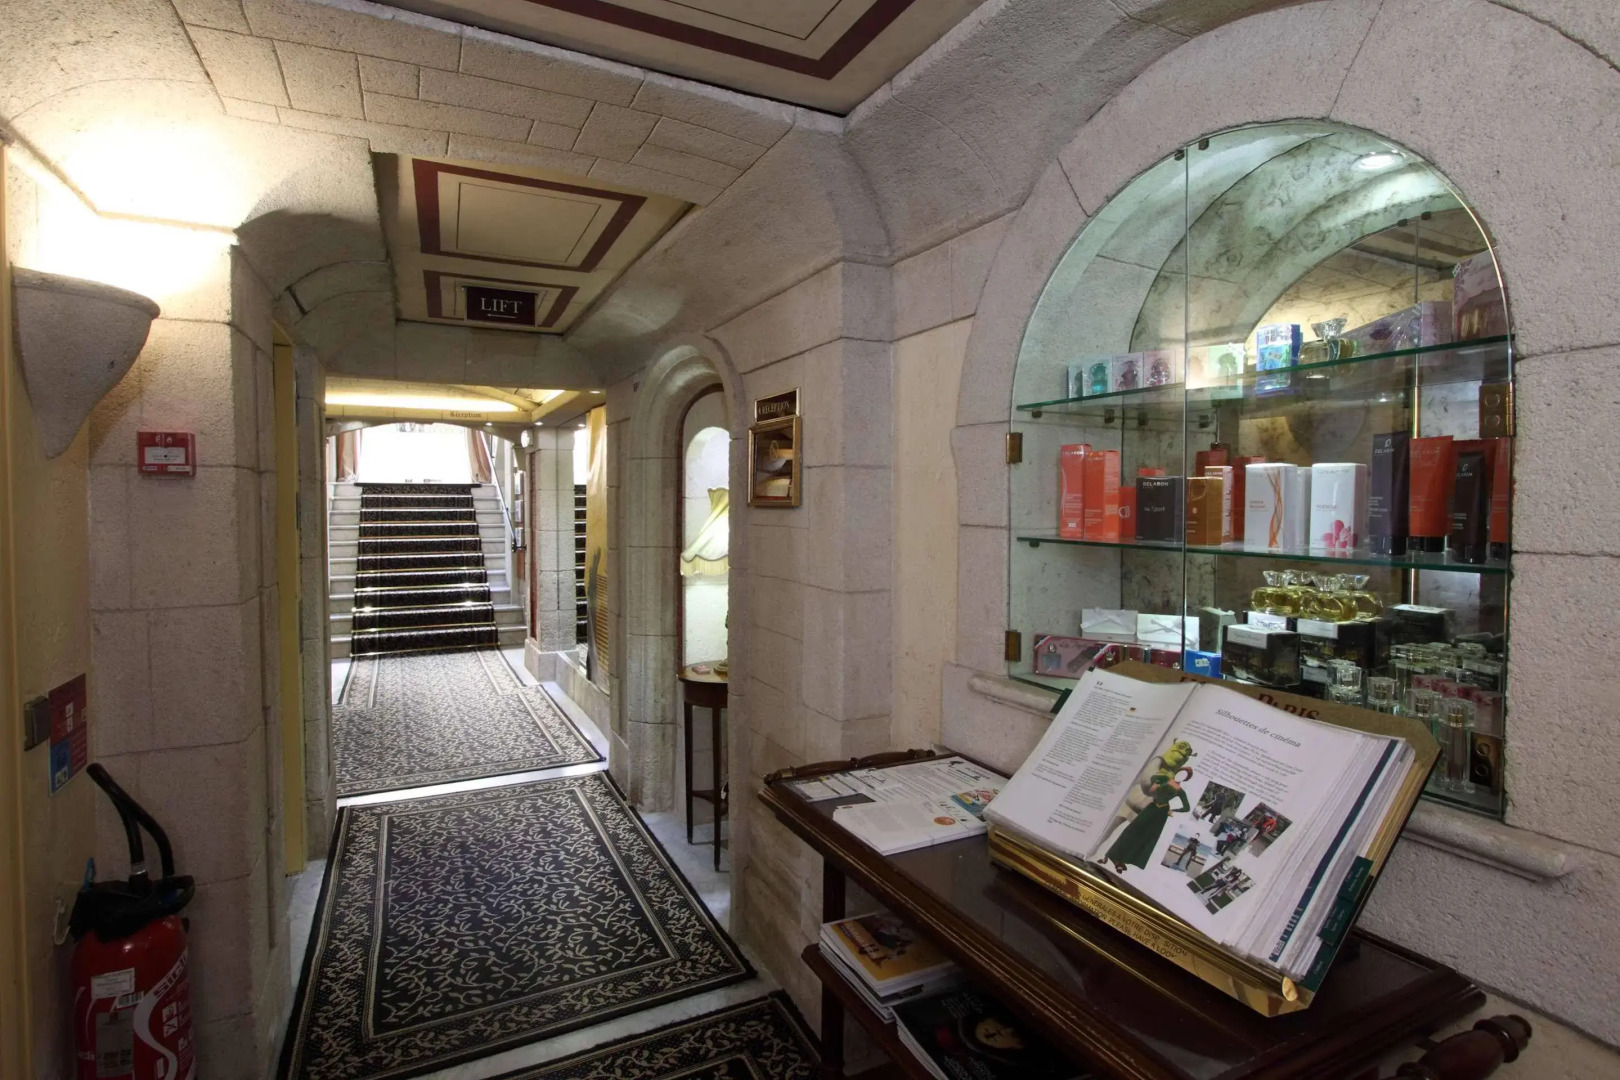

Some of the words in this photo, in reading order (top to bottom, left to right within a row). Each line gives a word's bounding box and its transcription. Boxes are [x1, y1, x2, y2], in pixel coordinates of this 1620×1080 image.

[480, 297, 523, 314] LIFT
[1215, 708, 1258, 731] Silhouettes
[1258, 726, 1270, 736] de
[1269, 731, 1302, 748] cinéma
